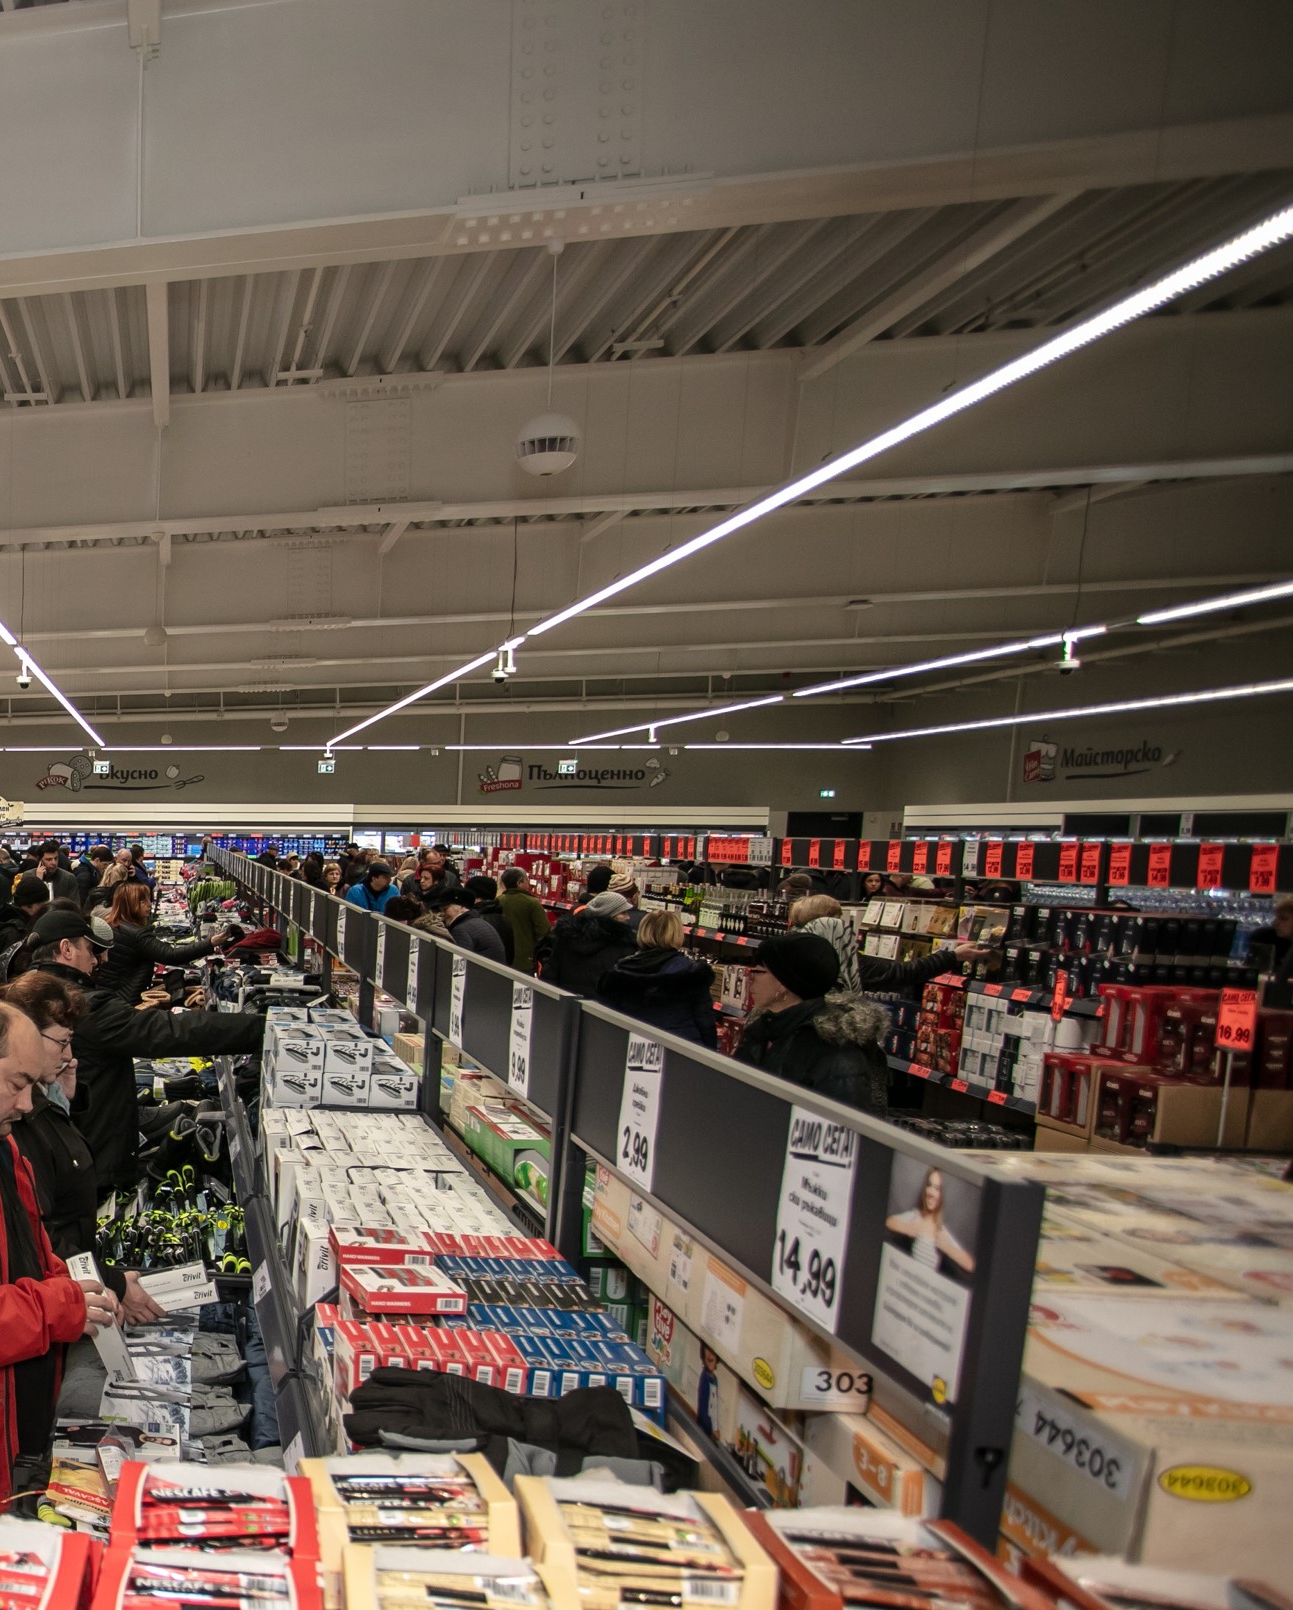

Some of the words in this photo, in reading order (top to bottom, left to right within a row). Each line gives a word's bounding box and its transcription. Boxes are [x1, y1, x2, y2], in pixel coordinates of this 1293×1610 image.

[1061, 740, 1161, 768] Майсторско
[483, 781, 519, 792] Freshona
[1219, 1024, 1251, 1044] 16,99
[628, 1041, 646, 1065] САМО
[511, 1051, 526, 1085] 9,99
[622, 1125, 648, 1173] 2,99
[790, 1118, 822, 1157] САМО
[822, 1124, 854, 1170] СЕГА!
[788, 1189, 801, 1205] ски
[801, 1198, 838, 1228] ръкавици
[78, 1256, 92, 1275] Crivit
[317, 1245, 330, 1271] Crivit
[778, 1227, 837, 1309] 14,99
[182, 1271, 202, 1283] Crivit
[193, 1289, 213, 1300] Crivit
[814, 1370, 874, 1395] 303
[1034, 1410, 1121, 1490] 303644
